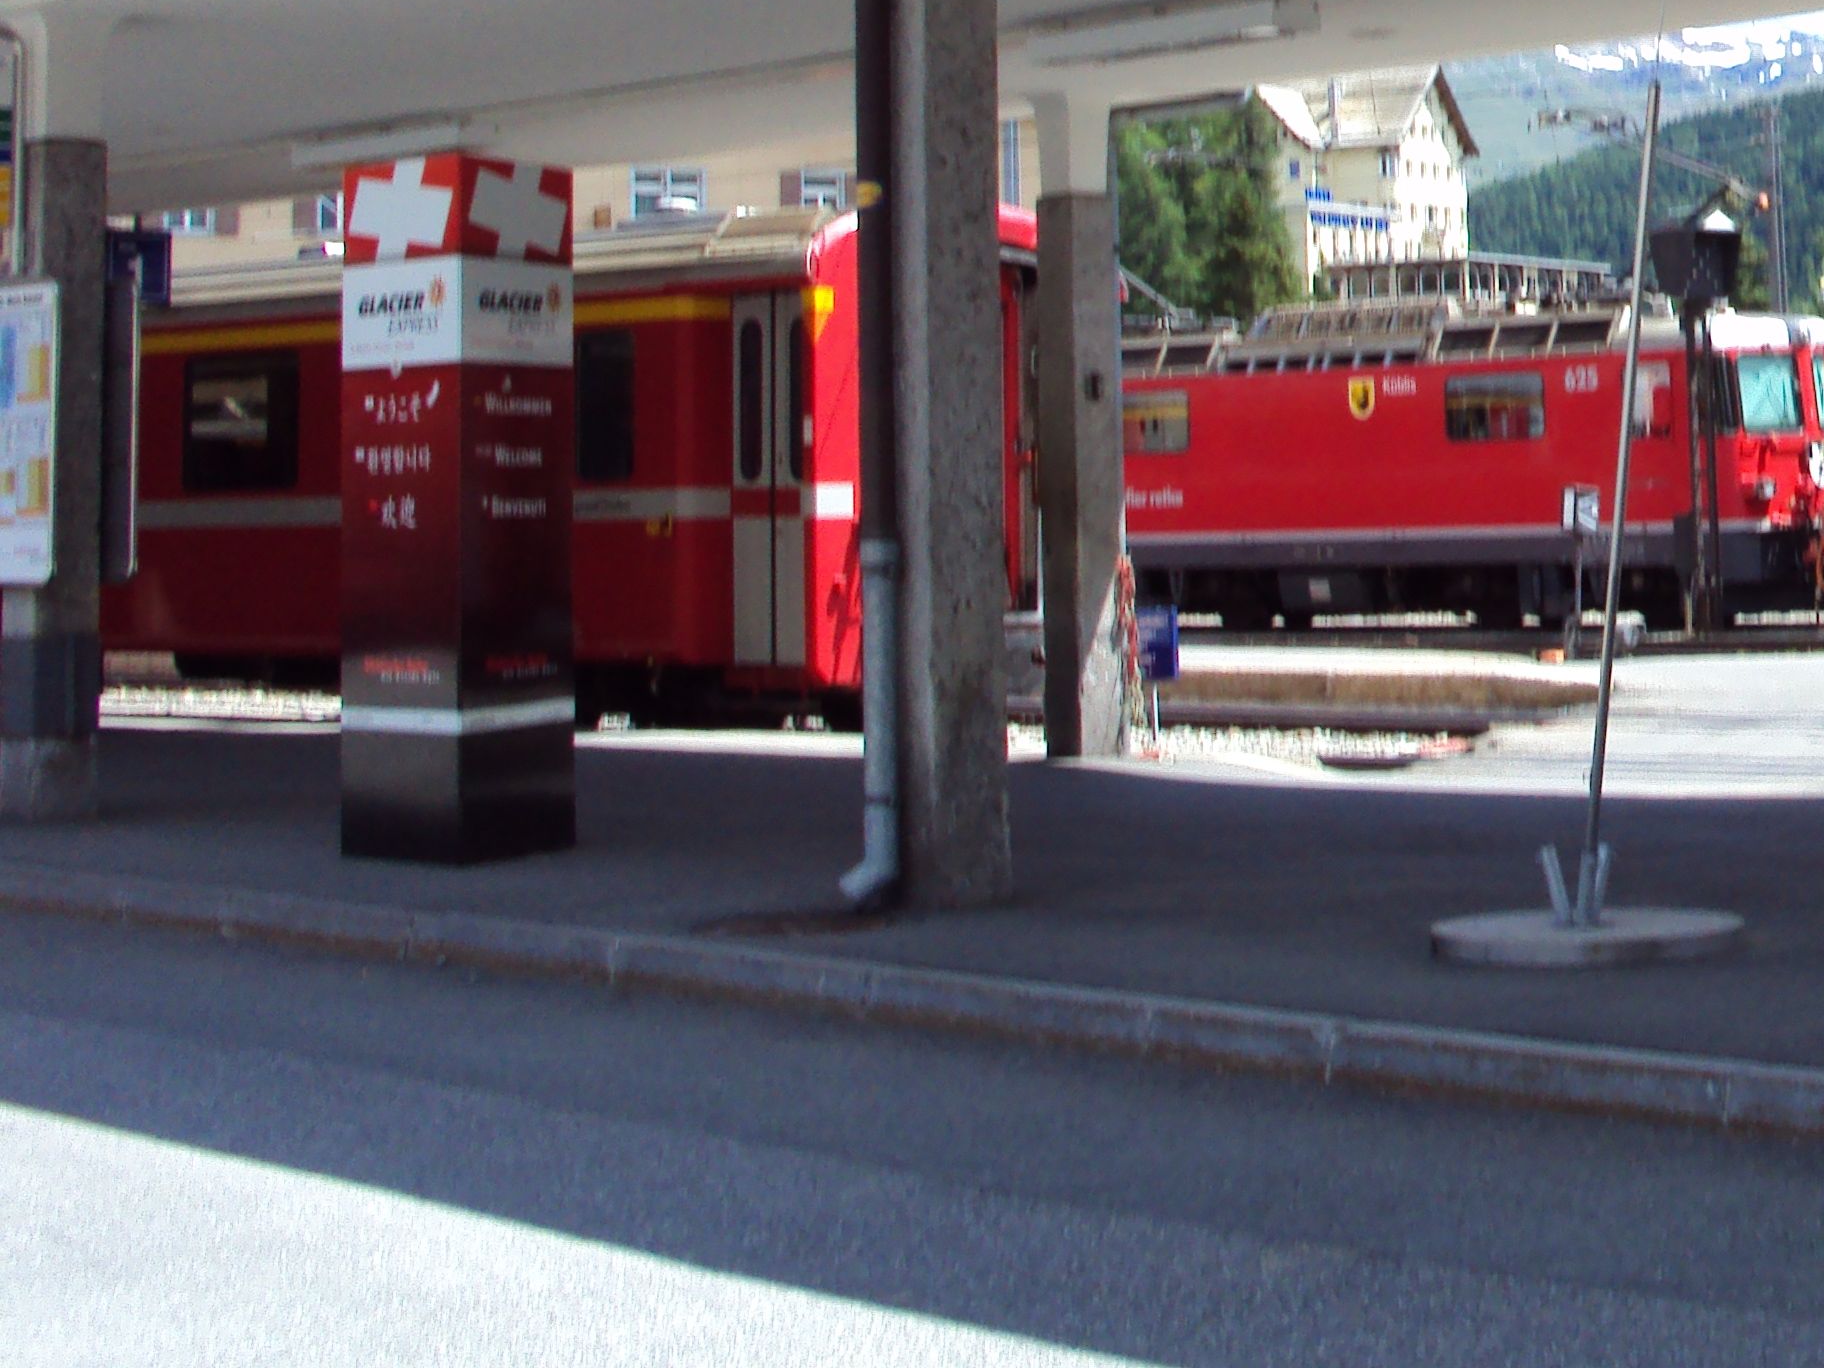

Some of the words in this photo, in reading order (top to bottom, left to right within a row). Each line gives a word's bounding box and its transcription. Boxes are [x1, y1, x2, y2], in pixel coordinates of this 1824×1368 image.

[358, 289, 425, 317] GLACIER
[478, 288, 544, 313] GLACIER
[1564, 365, 1599, 393] 625
